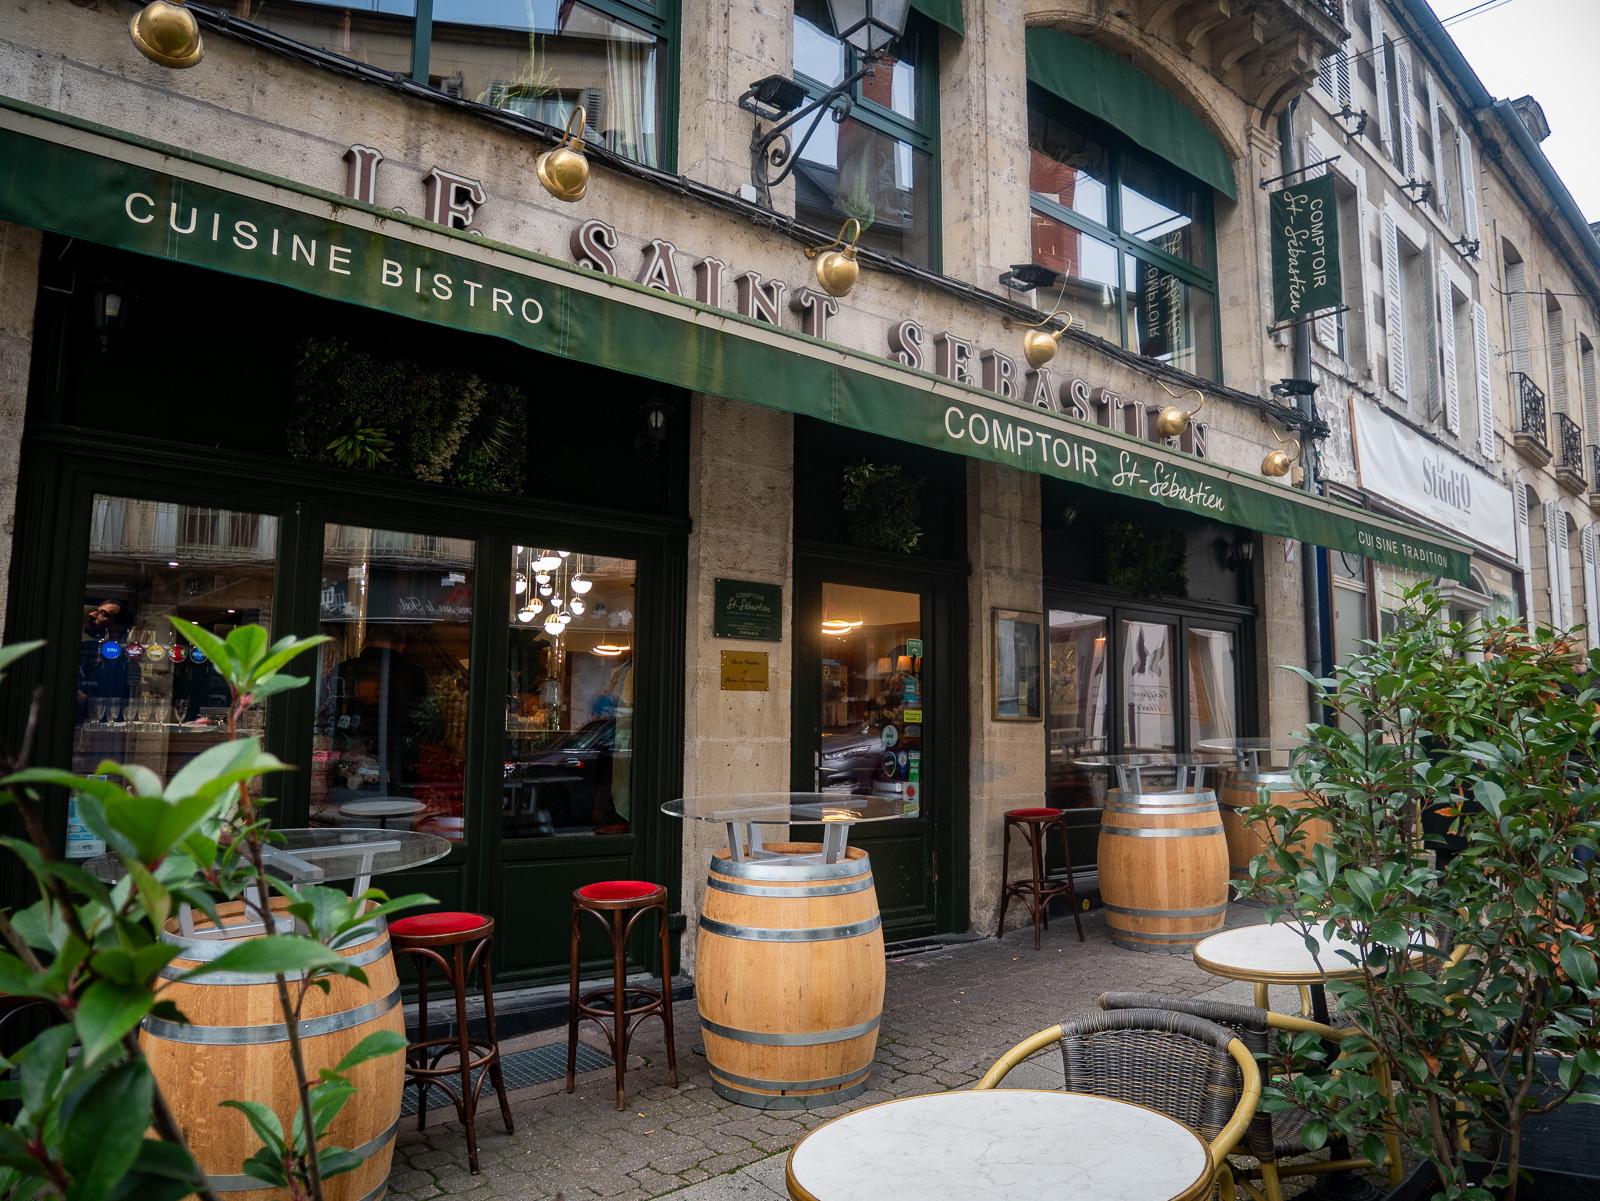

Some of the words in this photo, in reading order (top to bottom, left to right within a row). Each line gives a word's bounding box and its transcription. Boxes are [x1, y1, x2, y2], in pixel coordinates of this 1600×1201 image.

[124, 191, 352, 276] CUISINE
[381, 258, 545, 325] BISTRO
[569, 218, 839, 341] SAINT
[1310, 198, 1327, 289] COMPTOIR
[944, 406, 1099, 478] COMPTOIR
[1111, 450, 1226, 512] St-Sébastien
[1358, 530, 1399, 555] CUISINE
[1401, 543, 1448, 569] TRADITION
